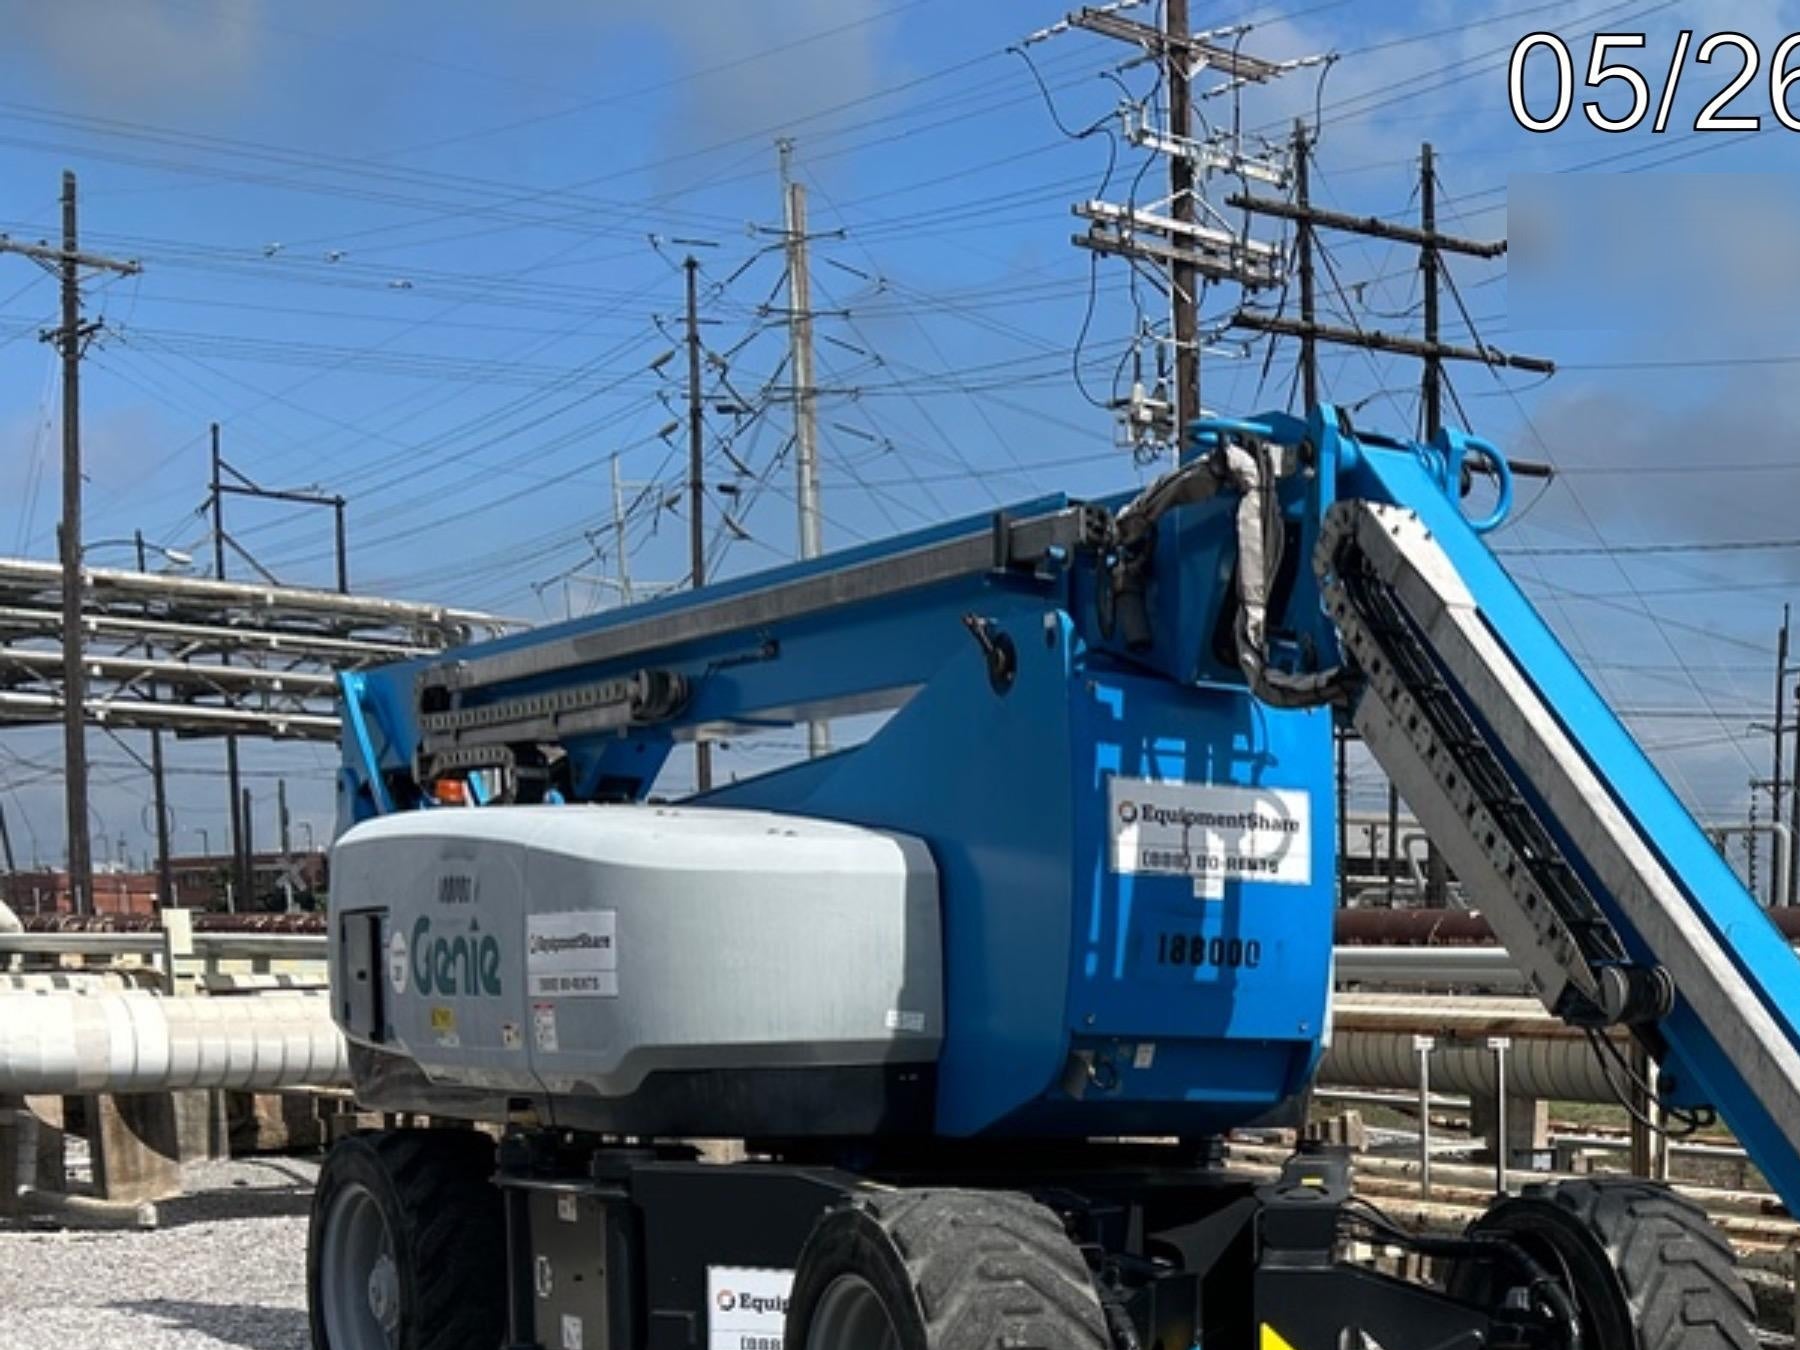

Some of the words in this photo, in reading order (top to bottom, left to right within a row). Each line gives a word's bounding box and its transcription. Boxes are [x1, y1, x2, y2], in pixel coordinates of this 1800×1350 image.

[1142, 804, 1300, 833] EquipmentShare
[410, 914, 502, 997] Genie
[1157, 931, 1262, 970] 188000
